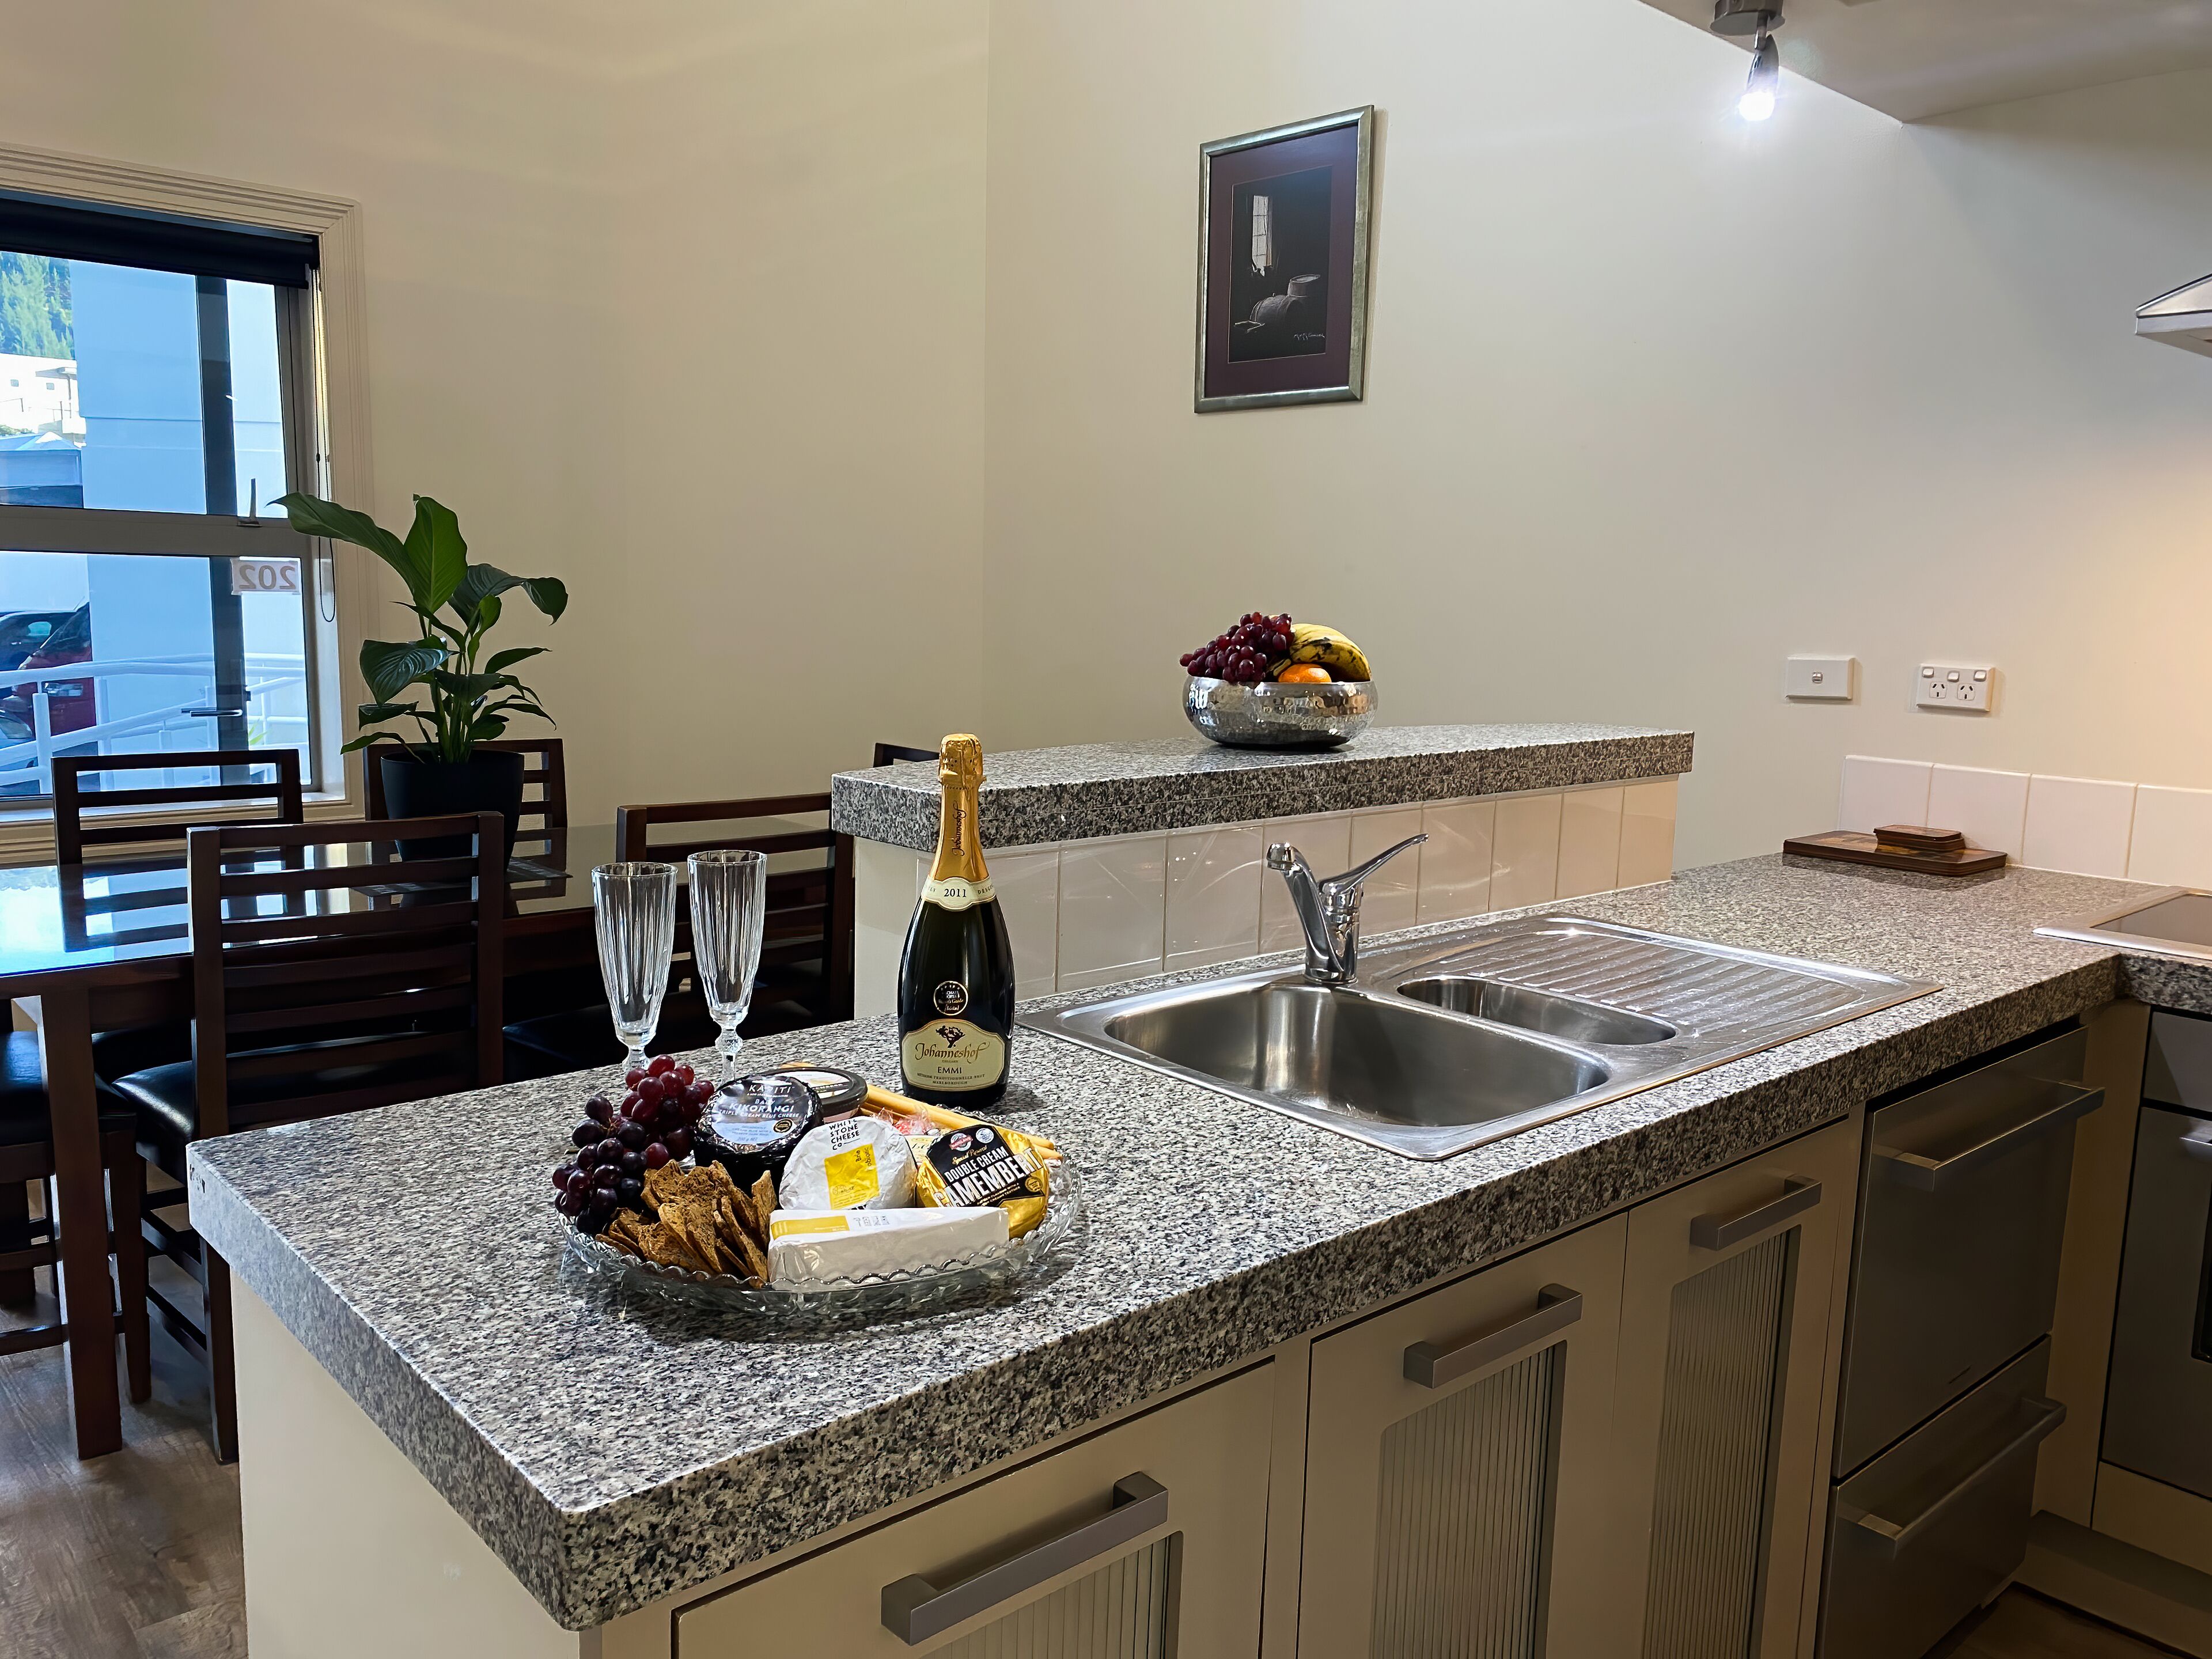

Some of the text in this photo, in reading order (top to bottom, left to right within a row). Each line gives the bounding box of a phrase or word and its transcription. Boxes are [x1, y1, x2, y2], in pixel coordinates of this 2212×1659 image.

[944, 888, 967, 897] 2011
[915, 1041, 990, 1064] Johanneshof
[729, 1103, 794, 1113] KIKORANGI
[830, 1123, 858, 1137] STONE
[831, 1130, 860, 1143] CHEESE
[832, 1142, 842, 1150] CO
[944, 1146, 1009, 1182] DOUBLE CREAM
[934, 1147, 1044, 1207] CAMEMBERT
